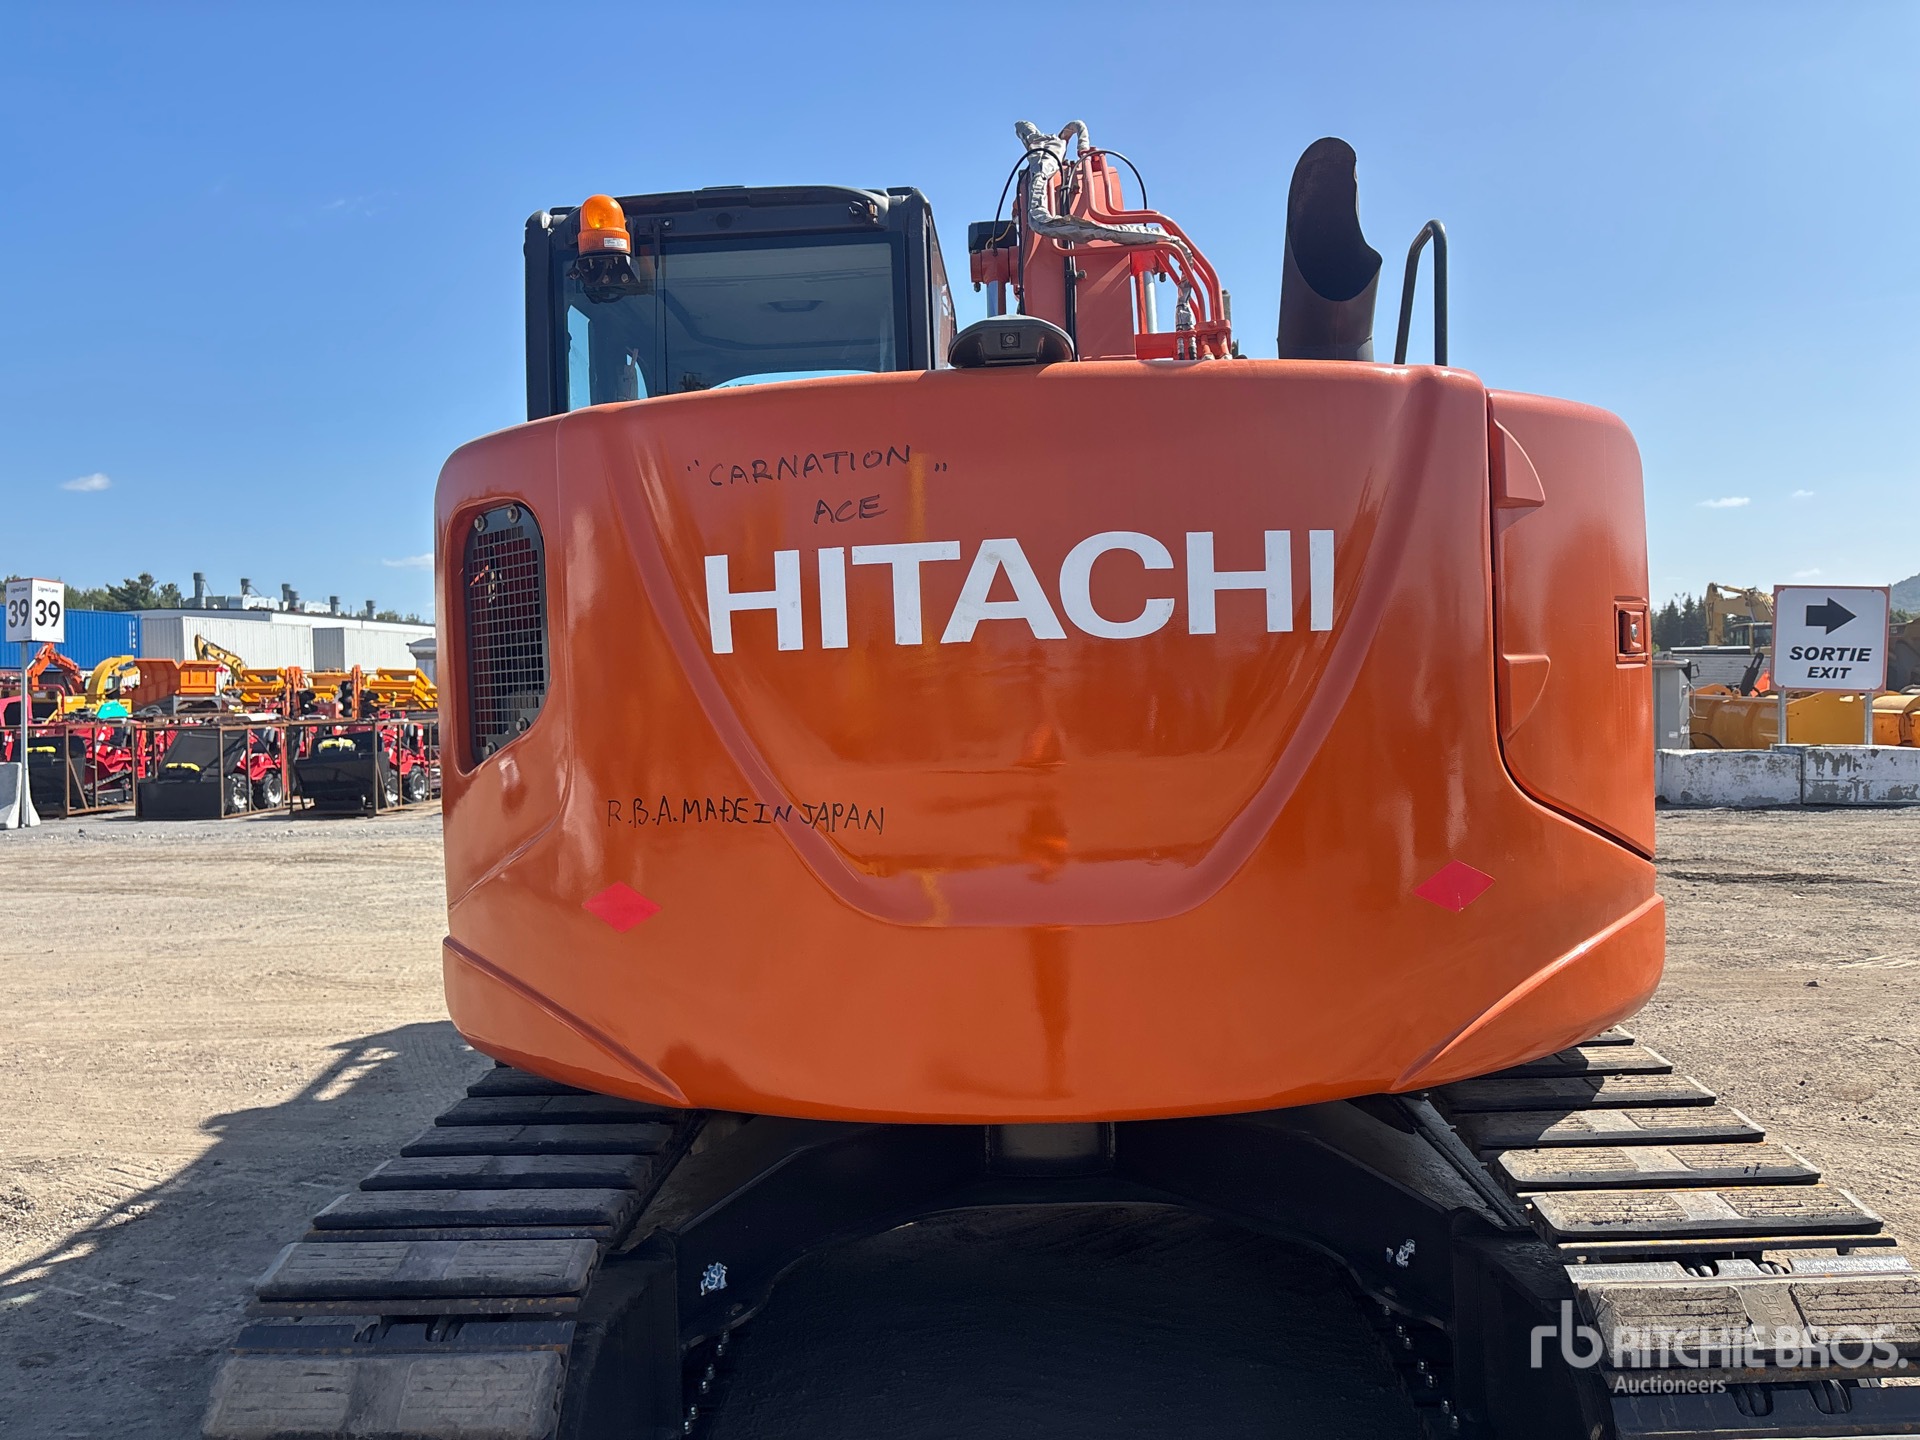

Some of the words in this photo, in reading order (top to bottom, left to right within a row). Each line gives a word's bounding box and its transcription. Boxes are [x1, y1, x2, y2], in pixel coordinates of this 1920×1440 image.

[813, 494, 888, 525] ACE
[704, 529, 1335, 654] HITACHI
[8, 598, 30, 628] 39
[34, 598, 61, 627] 39
[1789, 646, 1872, 663] SORTIE
[1807, 666, 1852, 680] EXIT
[753, 803, 792, 823] IN
[799, 801, 884, 835] JAPAN
